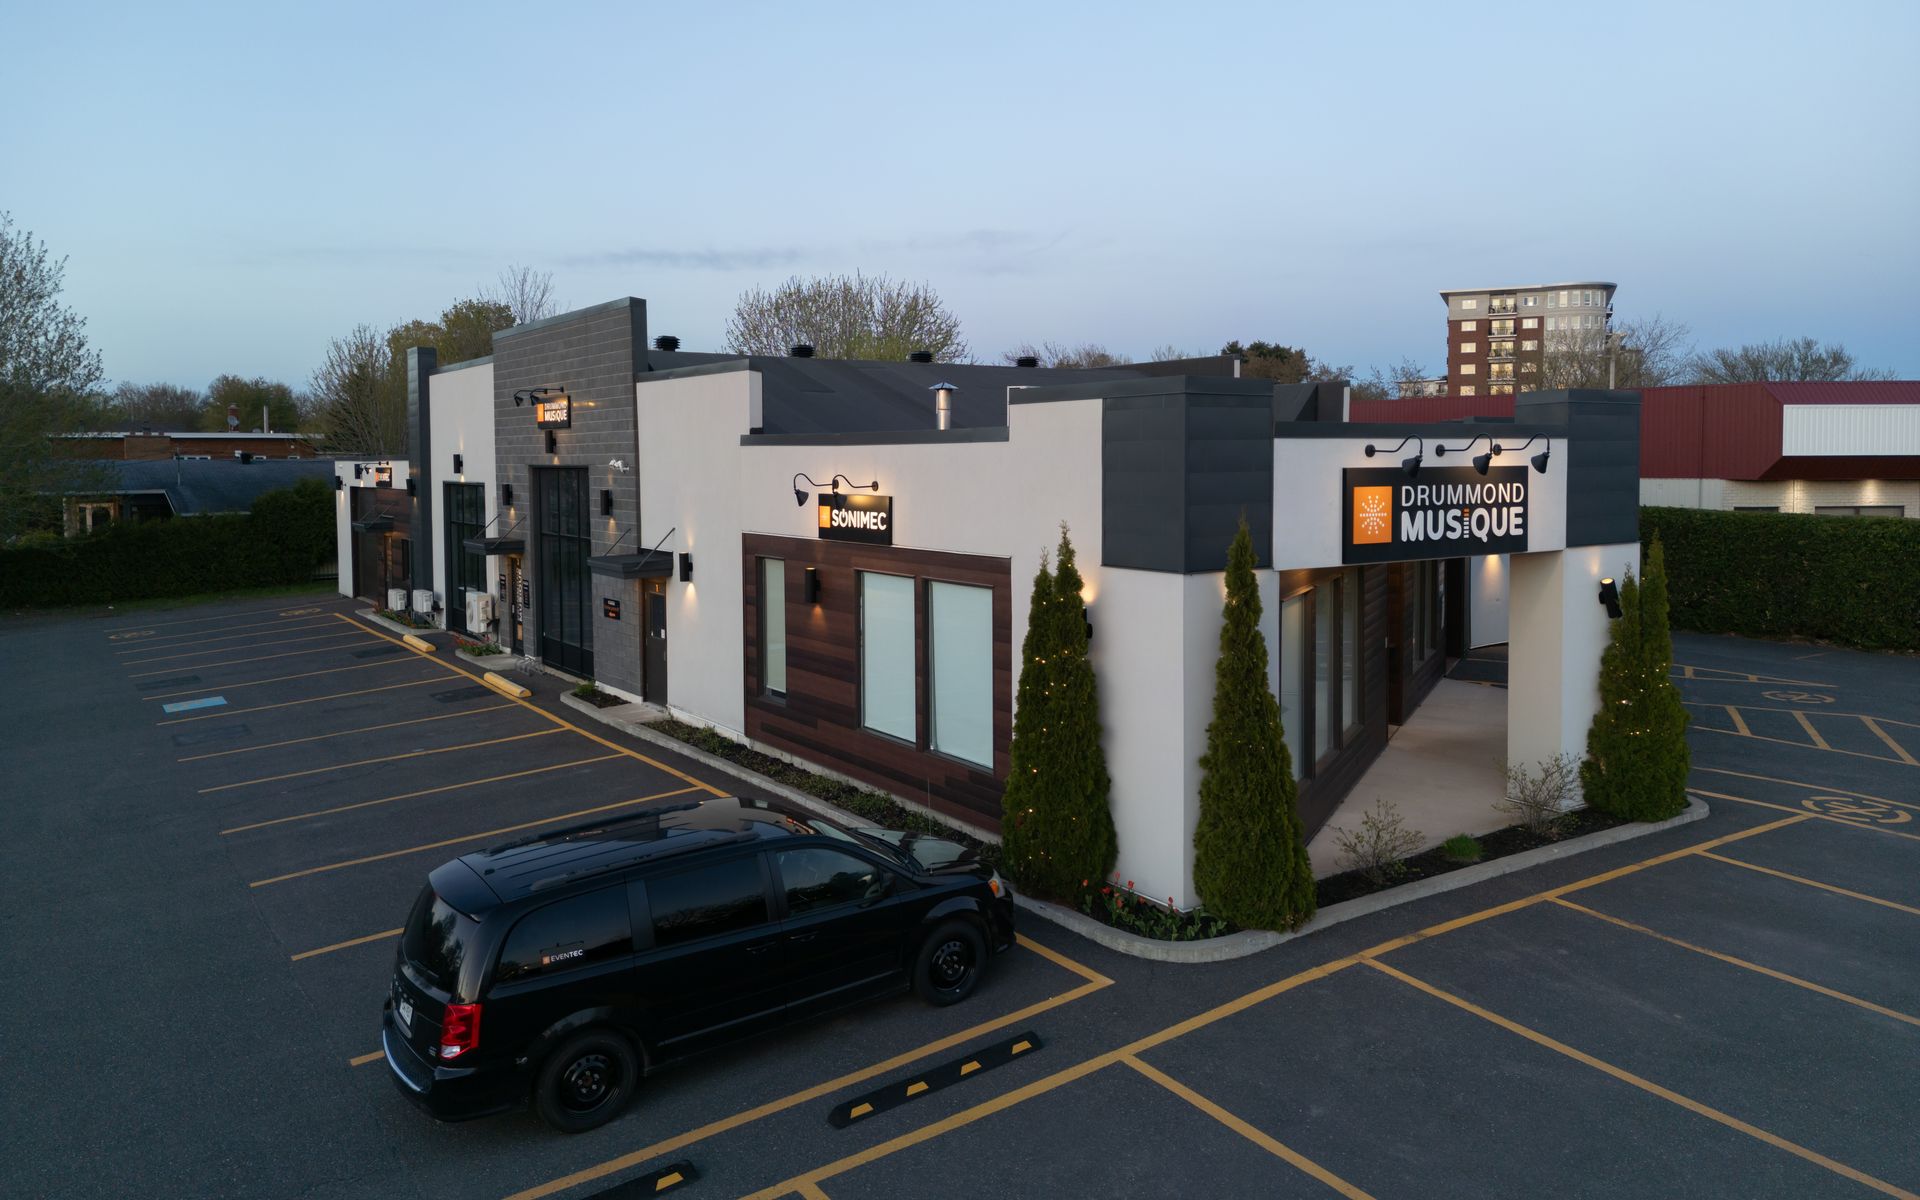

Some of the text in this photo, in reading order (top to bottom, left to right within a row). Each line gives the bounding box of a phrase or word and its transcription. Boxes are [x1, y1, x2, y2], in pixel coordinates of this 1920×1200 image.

[1401, 482, 1524, 506] DRUMMOND
[831, 508, 887, 531] SONIMEC
[1401, 506, 1524, 543] MUSIQUE
[550, 949, 584, 962] EVENTEC
